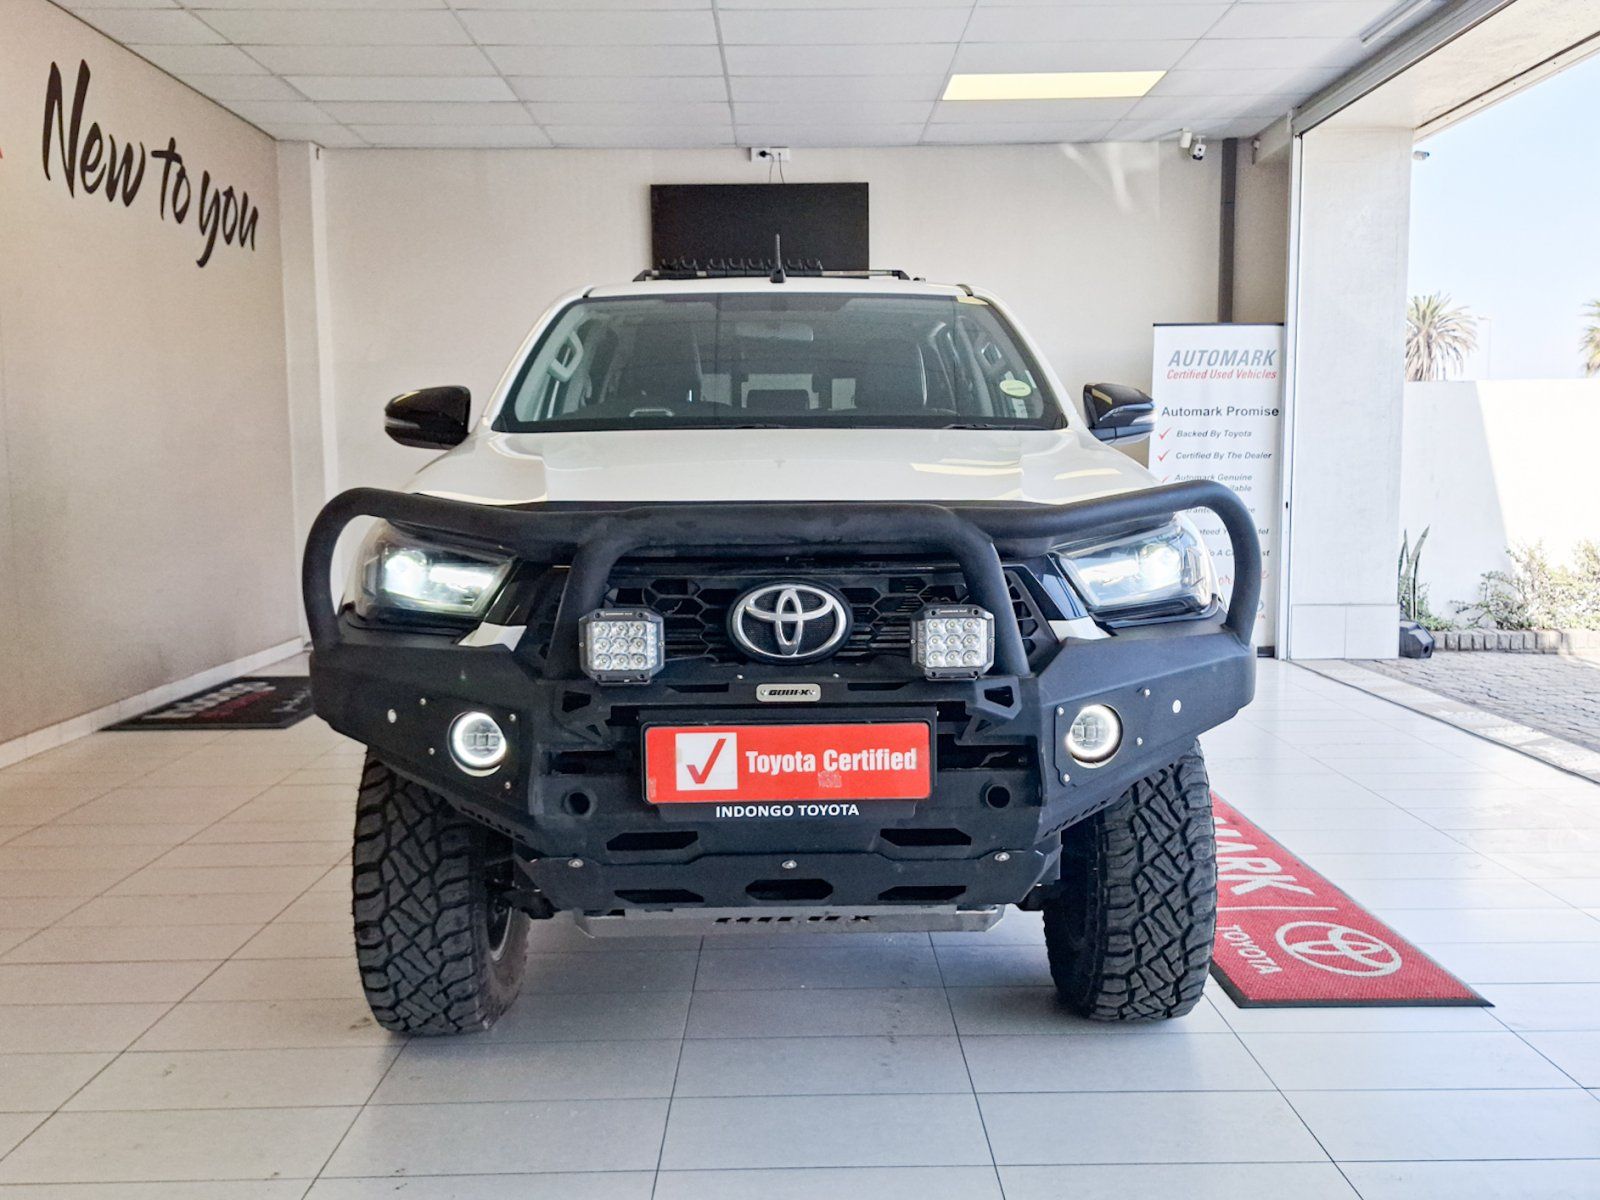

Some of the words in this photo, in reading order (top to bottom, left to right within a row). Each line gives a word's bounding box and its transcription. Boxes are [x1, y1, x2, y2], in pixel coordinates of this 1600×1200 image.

[43, 59, 146, 207] New
[151, 137, 191, 224] to
[196, 170, 258, 268] you
[1167, 349, 1277, 367] AUTOMARK
[1166, 369, 1207, 380] Certified
[1210, 370, 1233, 379] Used
[1236, 369, 1277, 379] Vehicles
[1161, 406, 1222, 417] Automark
[1226, 405, 1280, 417] Promise
[1176, 430, 1208, 438] Backed
[1210, 430, 1222, 439] By
[1224, 429, 1252, 439] Toyota
[1175, 452, 1211, 460] Certified
[1213, 452, 1225, 461] By
[1227, 452, 1243, 460] The
[1244, 452, 1272, 460] Dealer
[1217, 473, 1253, 482] Genuine
[745, 750, 816, 774] Toyota
[823, 747, 917, 772] Certified
[715, 805, 794, 818] INDONGO
[798, 804, 860, 817] TOYOTA
[1215, 924, 1283, 975] TOYOTA
